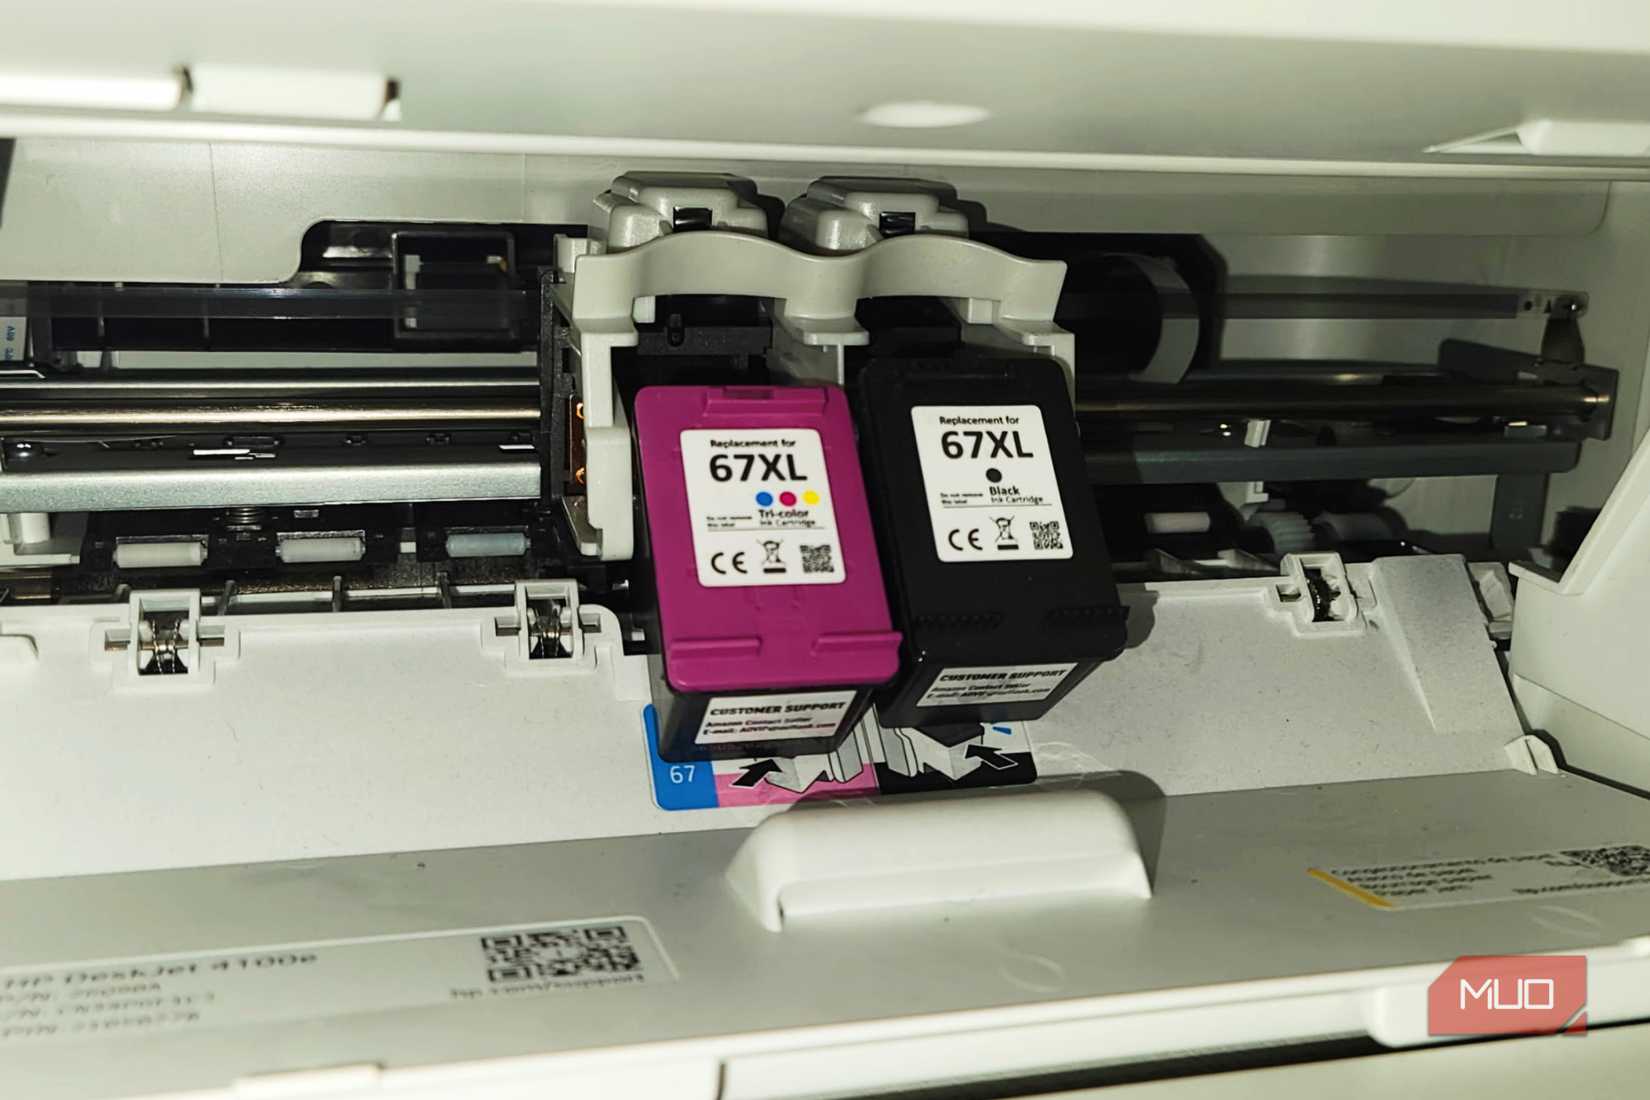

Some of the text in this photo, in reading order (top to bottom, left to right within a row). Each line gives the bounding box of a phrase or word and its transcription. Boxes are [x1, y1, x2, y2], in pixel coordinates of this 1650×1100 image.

[939, 416, 1020, 426] Replacement for
[710, 439, 796, 449] Replacement for
[941, 431, 1034, 459] 67XL
[709, 454, 808, 482] 67XL
[990, 486, 1020, 496] Black
[1006, 496, 1044, 505] Cartridge
[759, 509, 809, 518] Tri-color
[775, 519, 816, 528] Cartridge
[940, 669, 1068, 682] CUSTOMER SUPPORT
[710, 702, 846, 716] CUSTOMER SUPPORT
[669, 765, 696, 784] 67
[64, 963, 198, 984] DeskJet
[212, 954, 318, 970] 4100e
